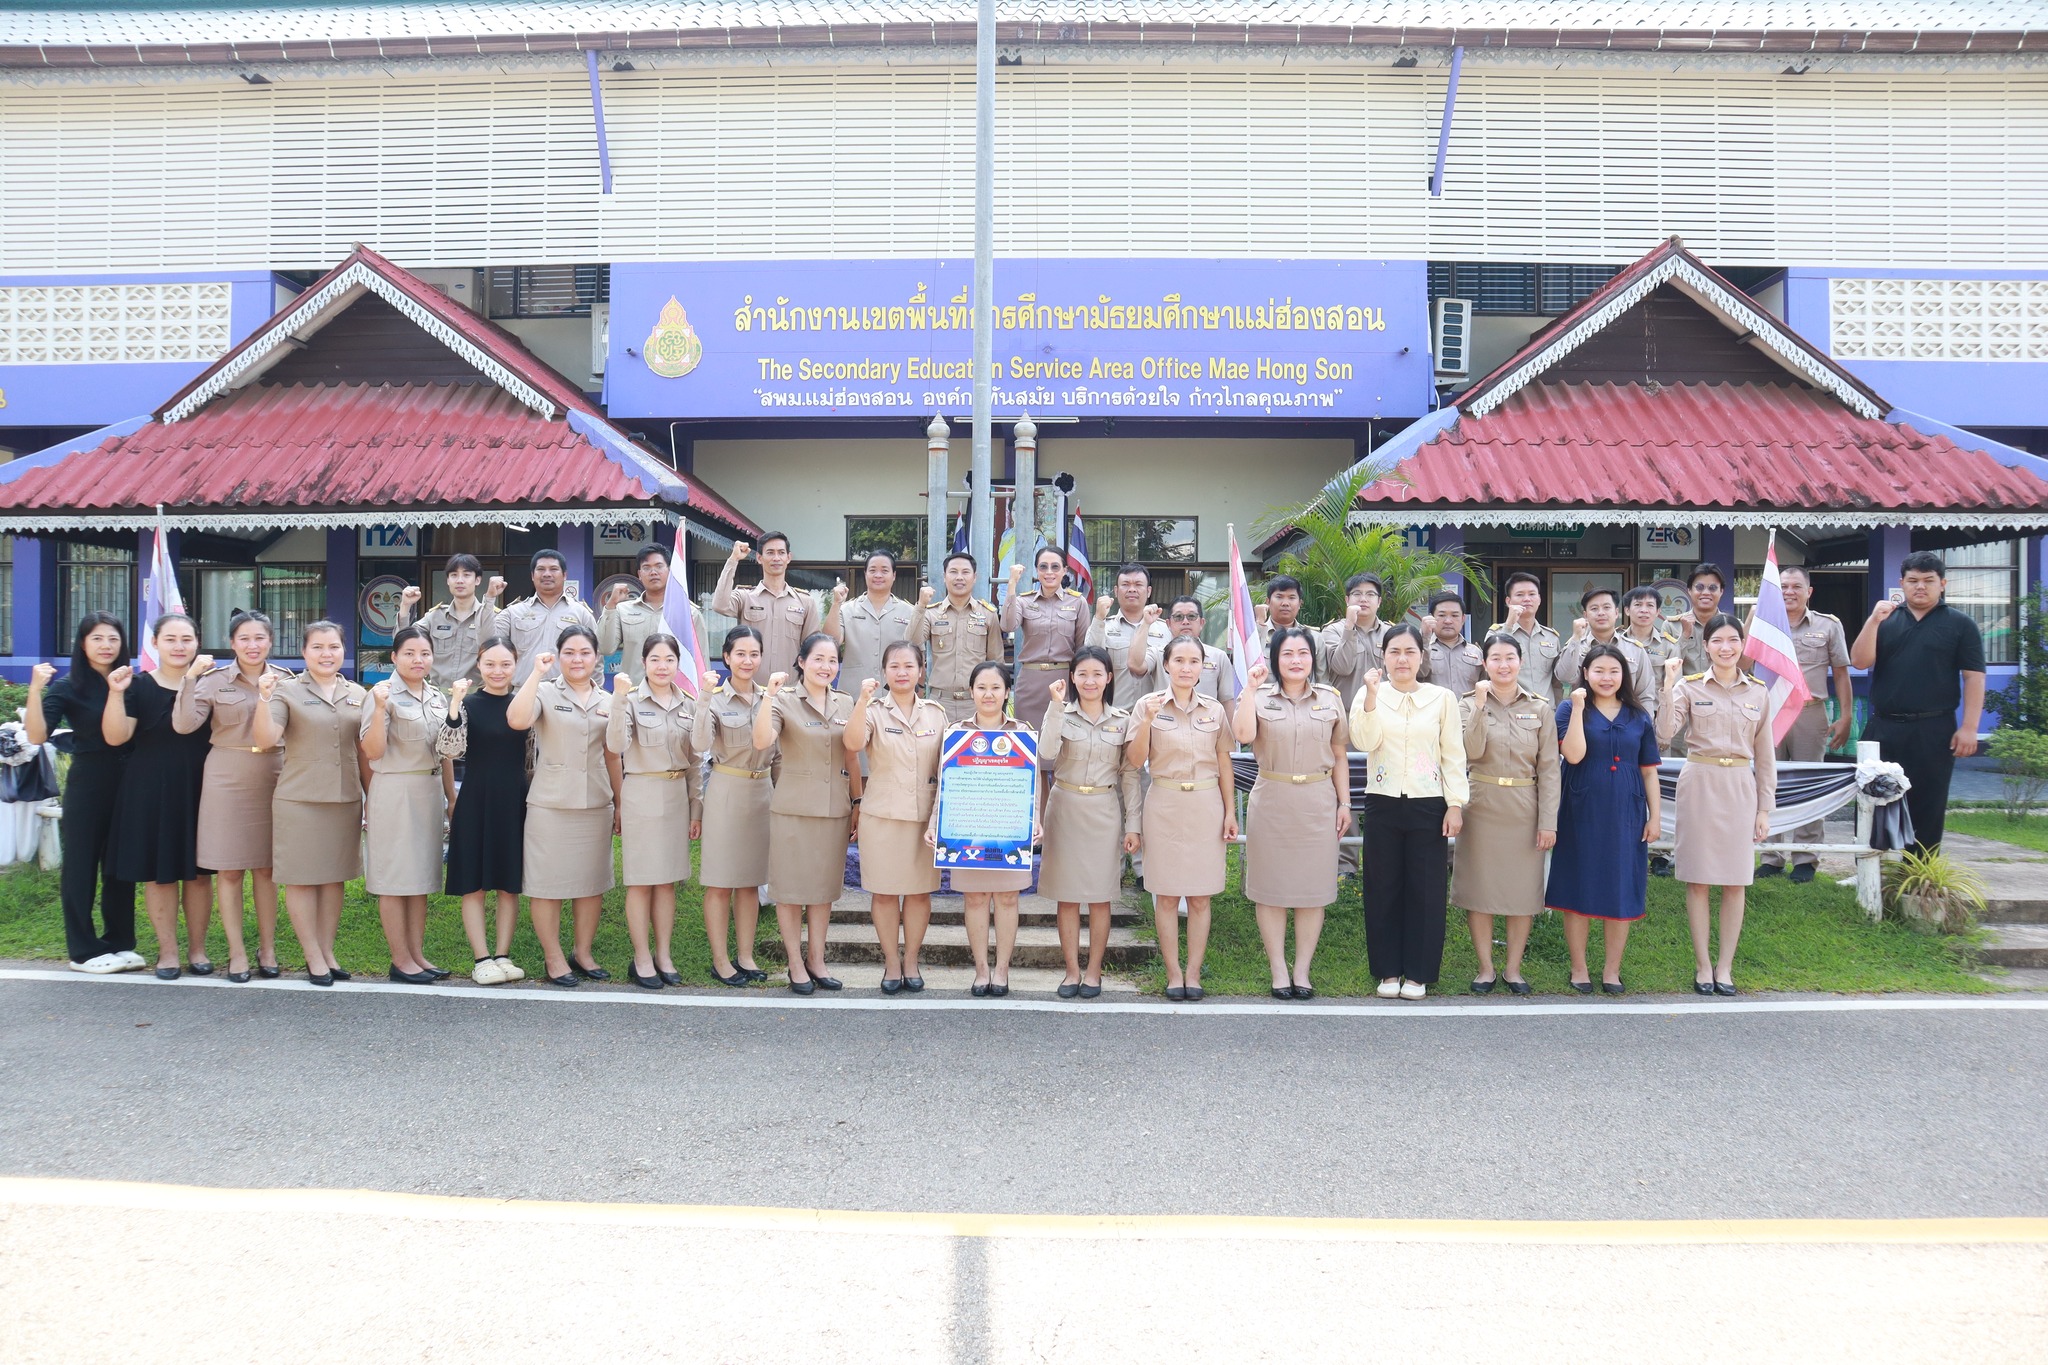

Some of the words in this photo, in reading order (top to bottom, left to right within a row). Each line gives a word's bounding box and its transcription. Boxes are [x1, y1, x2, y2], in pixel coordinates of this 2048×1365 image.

[758, 358, 793, 381] The
[799, 357, 901, 385] Secondary
[907, 357, 1003, 380] Educatn
[1010, 355, 1083, 380] Service
[1089, 357, 1134, 380] Area
[1141, 356, 1202, 380] Office
[1209, 357, 1250, 380] Mae
[1256, 357, 1308, 386] Hong
[1315, 357, 1353, 380] Son
[922, 386, 1055, 407] องค์กทันสมัย
[1061, 384, 1180, 407] บริการด้วยใจ
